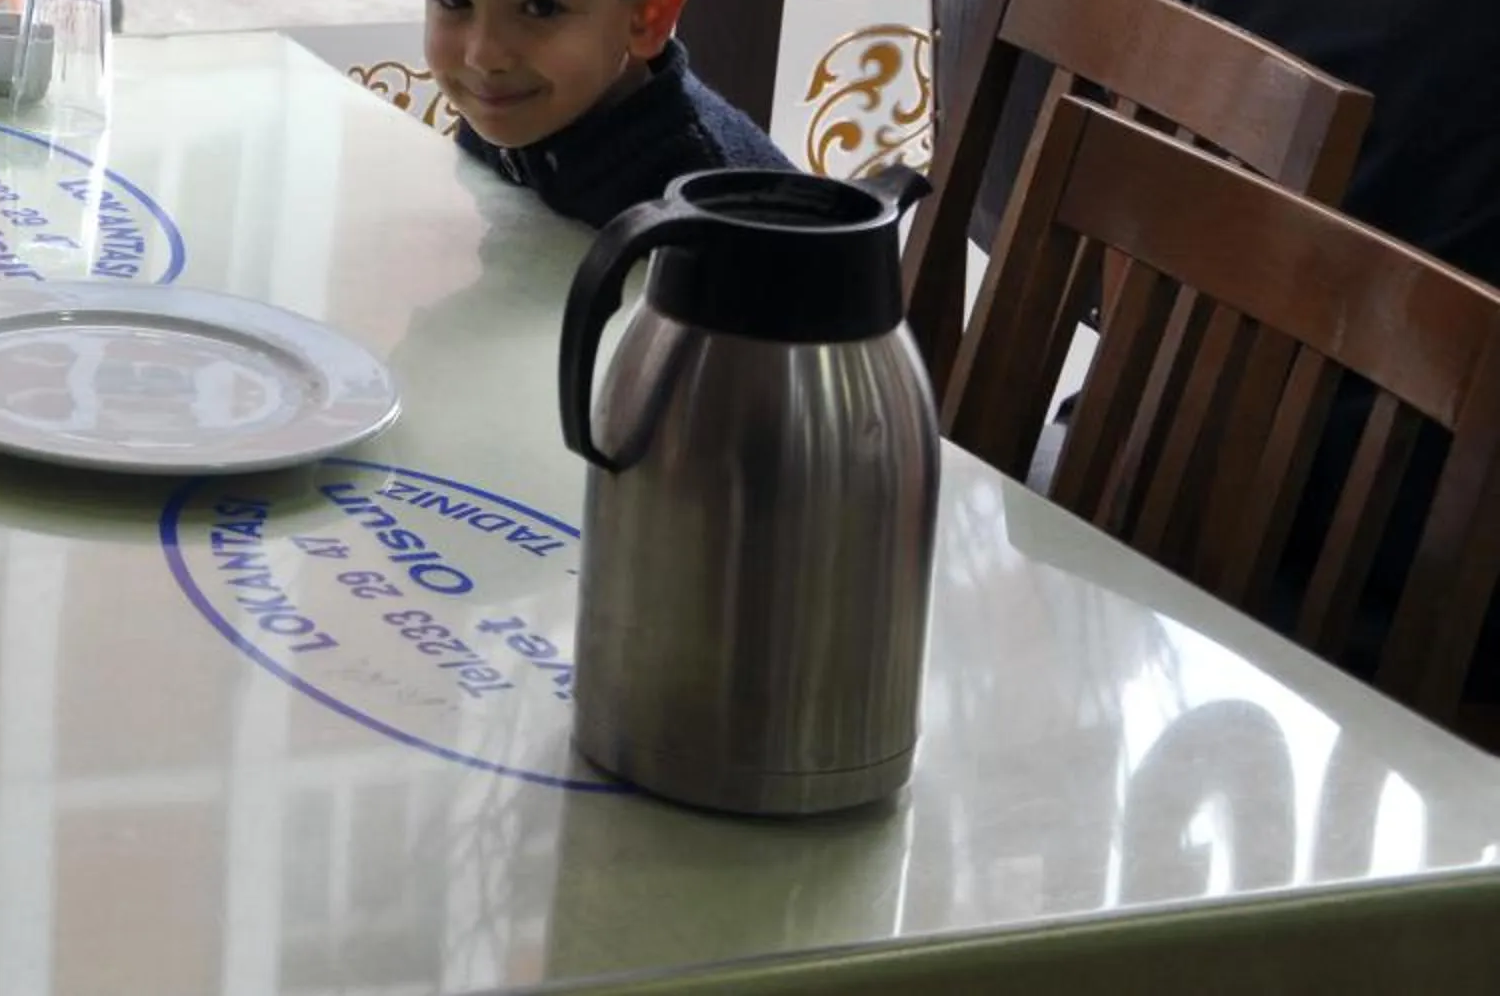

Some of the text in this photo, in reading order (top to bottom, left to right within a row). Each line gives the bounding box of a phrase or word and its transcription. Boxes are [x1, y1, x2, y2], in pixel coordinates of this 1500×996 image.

[290, 536, 351, 559] 47
[321, 483, 474, 595] Olsun
[375, 481, 564, 556] TADINIZ
[210, 498, 340, 652] LOKANTASI
[337, 571, 404, 599] 29
